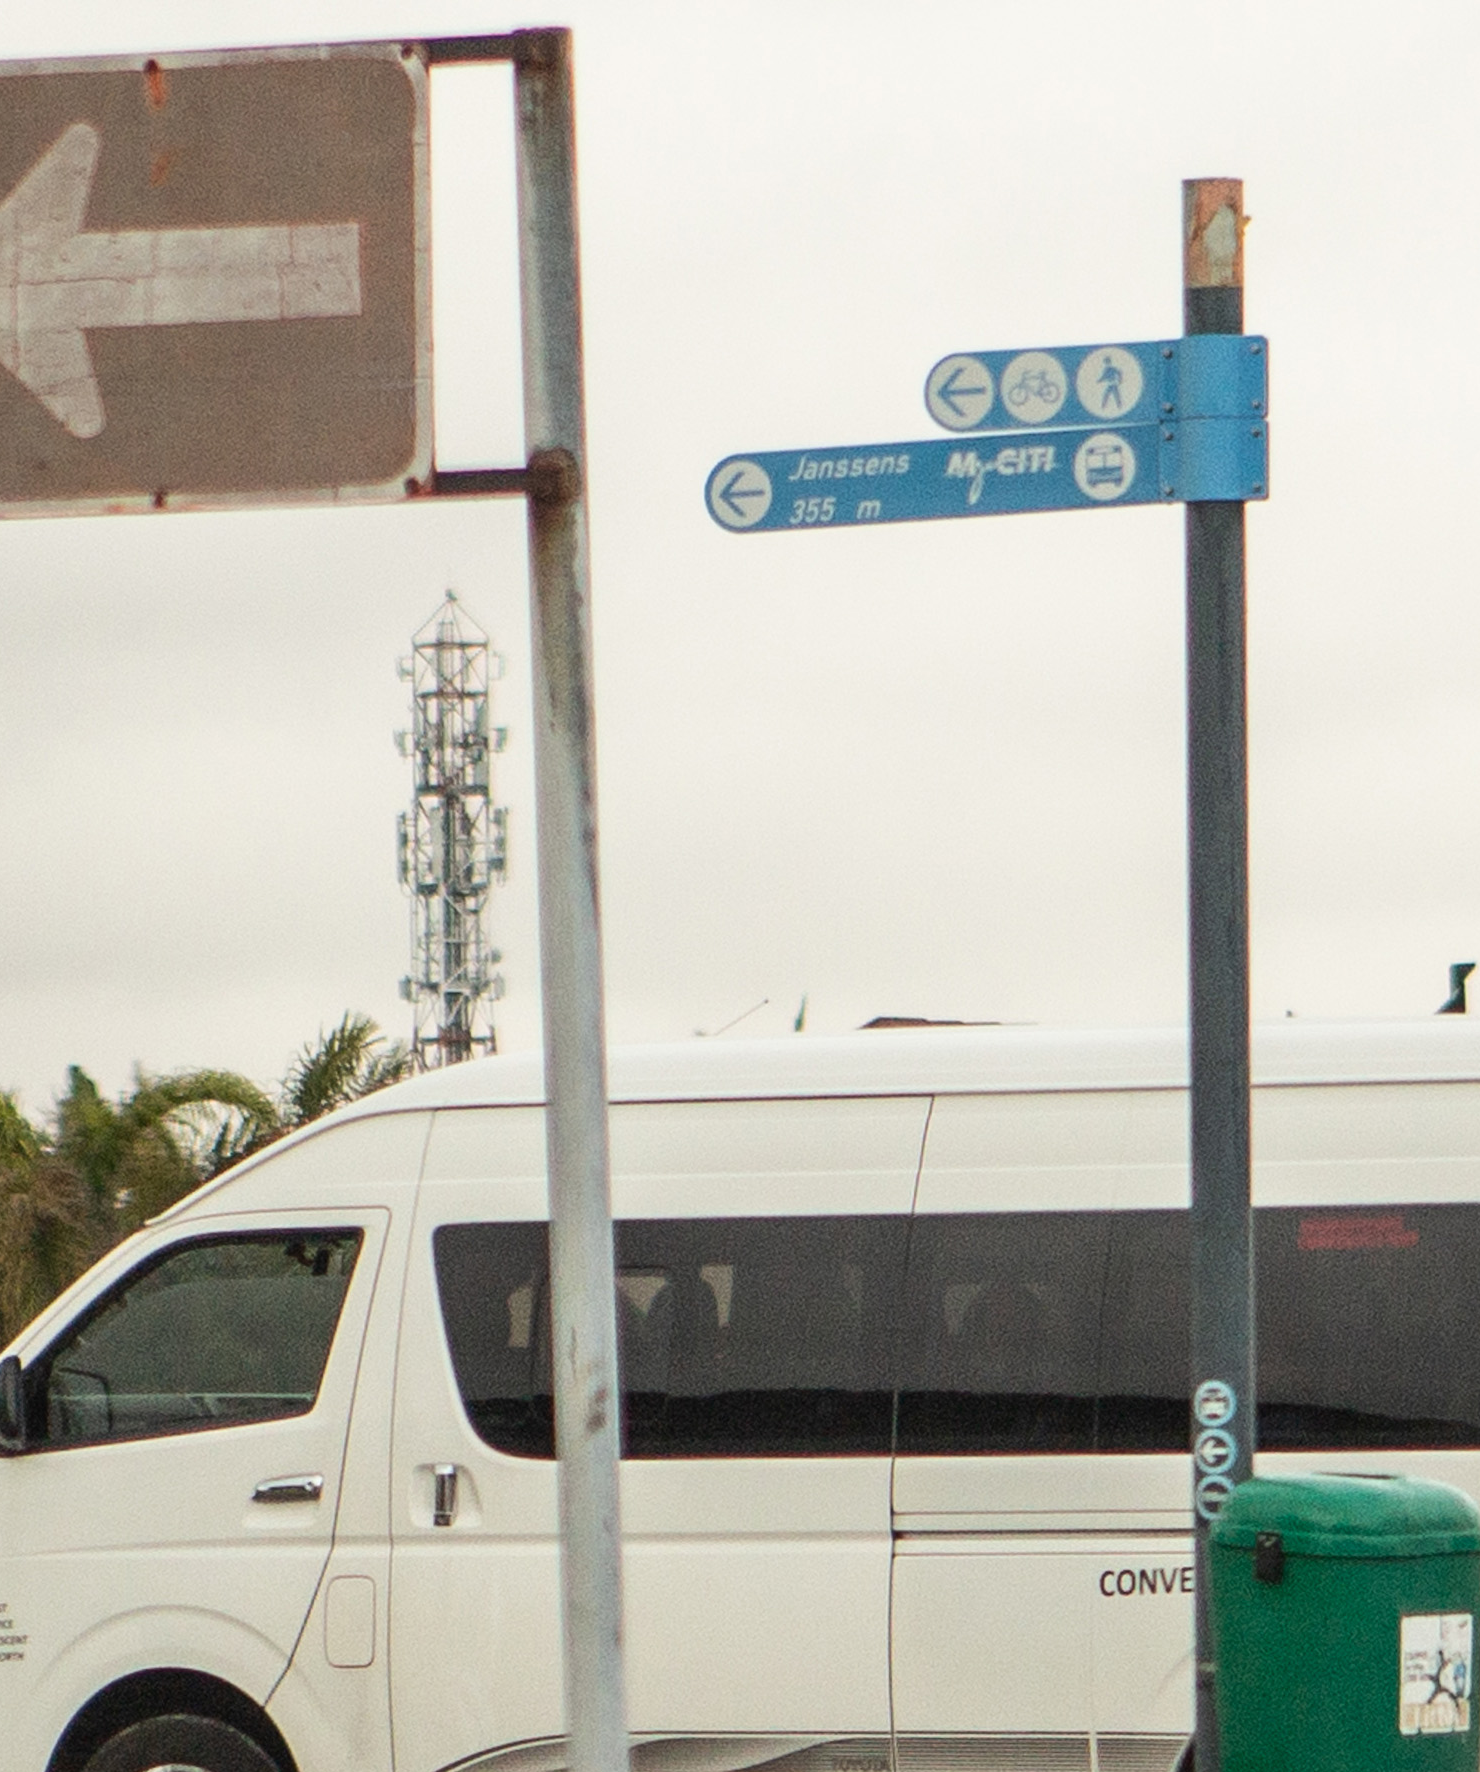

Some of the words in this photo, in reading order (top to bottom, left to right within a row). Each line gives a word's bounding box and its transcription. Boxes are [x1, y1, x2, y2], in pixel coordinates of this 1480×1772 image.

[788, 453, 910, 482] Janssens
[789, 496, 836, 525] 355
[856, 500, 882, 520] m
